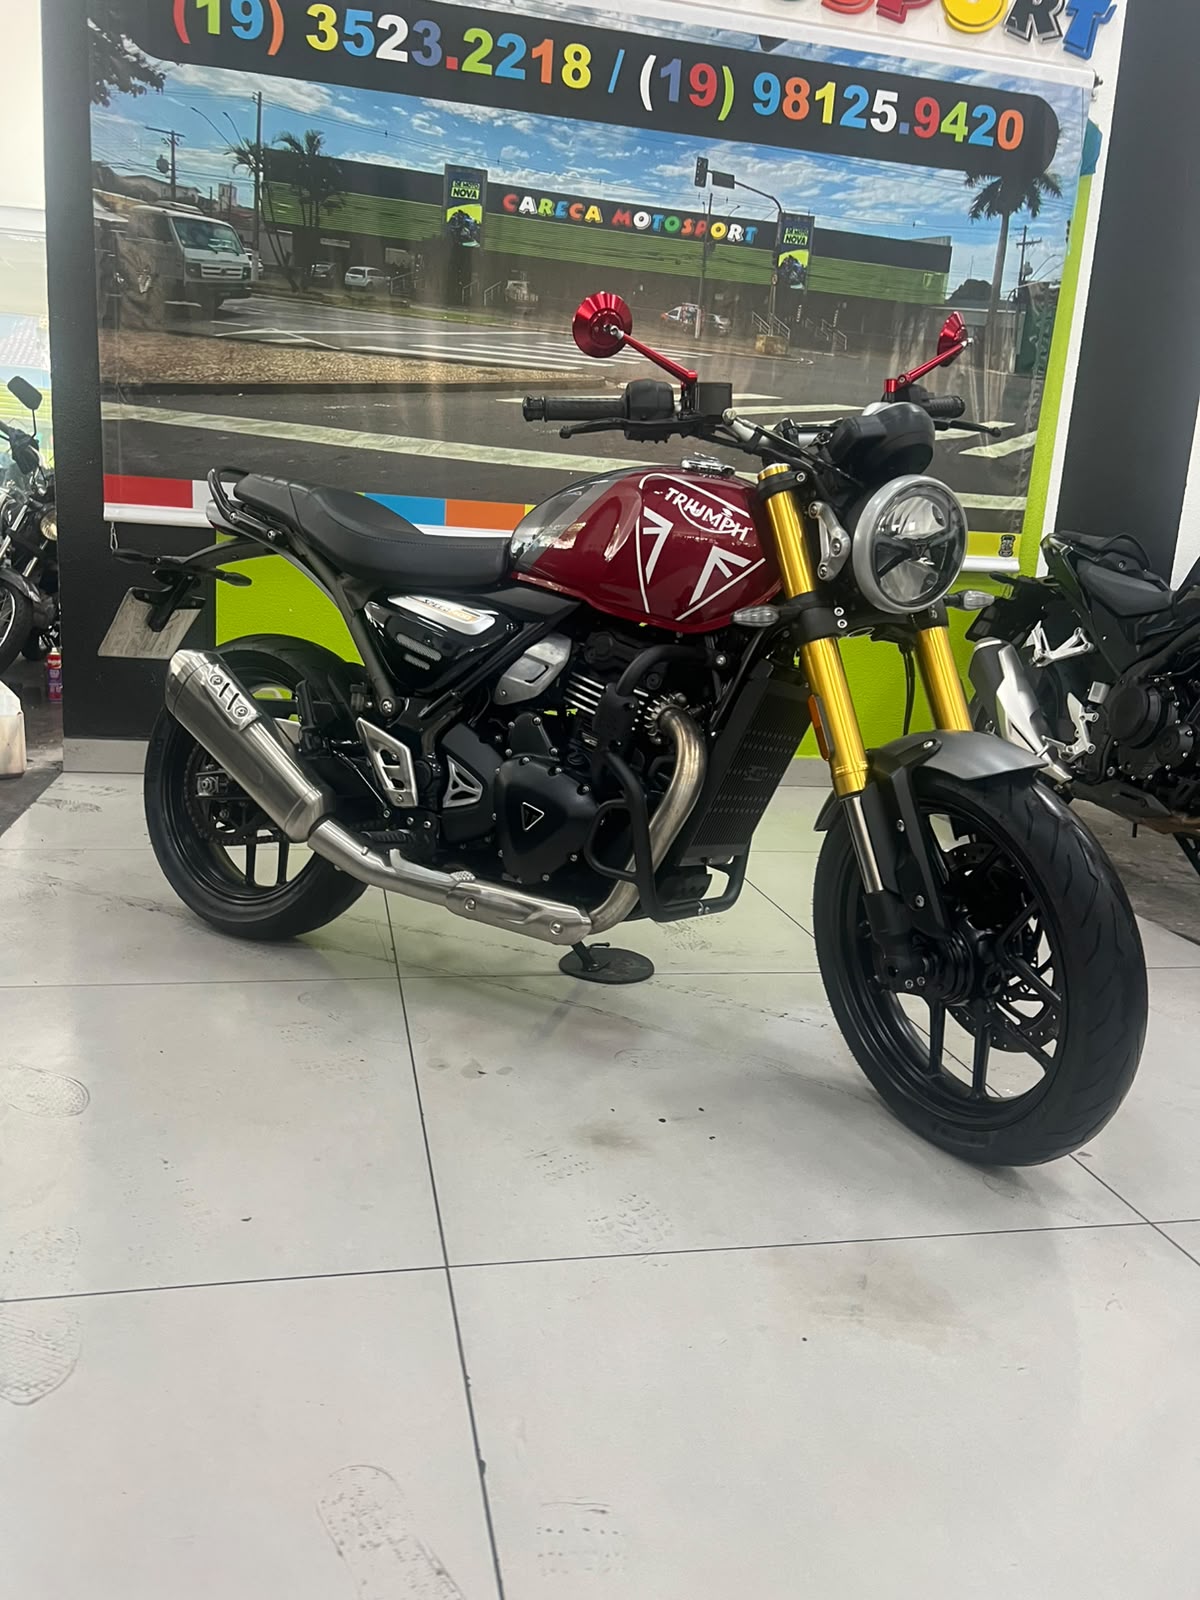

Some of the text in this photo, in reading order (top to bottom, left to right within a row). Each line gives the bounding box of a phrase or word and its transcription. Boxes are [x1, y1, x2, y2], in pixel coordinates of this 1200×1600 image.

[305, 3, 593, 90] 3523.2218
[640, 55, 735, 121] (19)
[752, 72, 1025, 151] 98125.9420
[453, 188, 477, 199] NOVA
[503, 193, 758, 244] CARECA MOTOSPORT
[785, 234, 805, 246] NOVA
[664, 487, 750, 541] TRIUMPH
